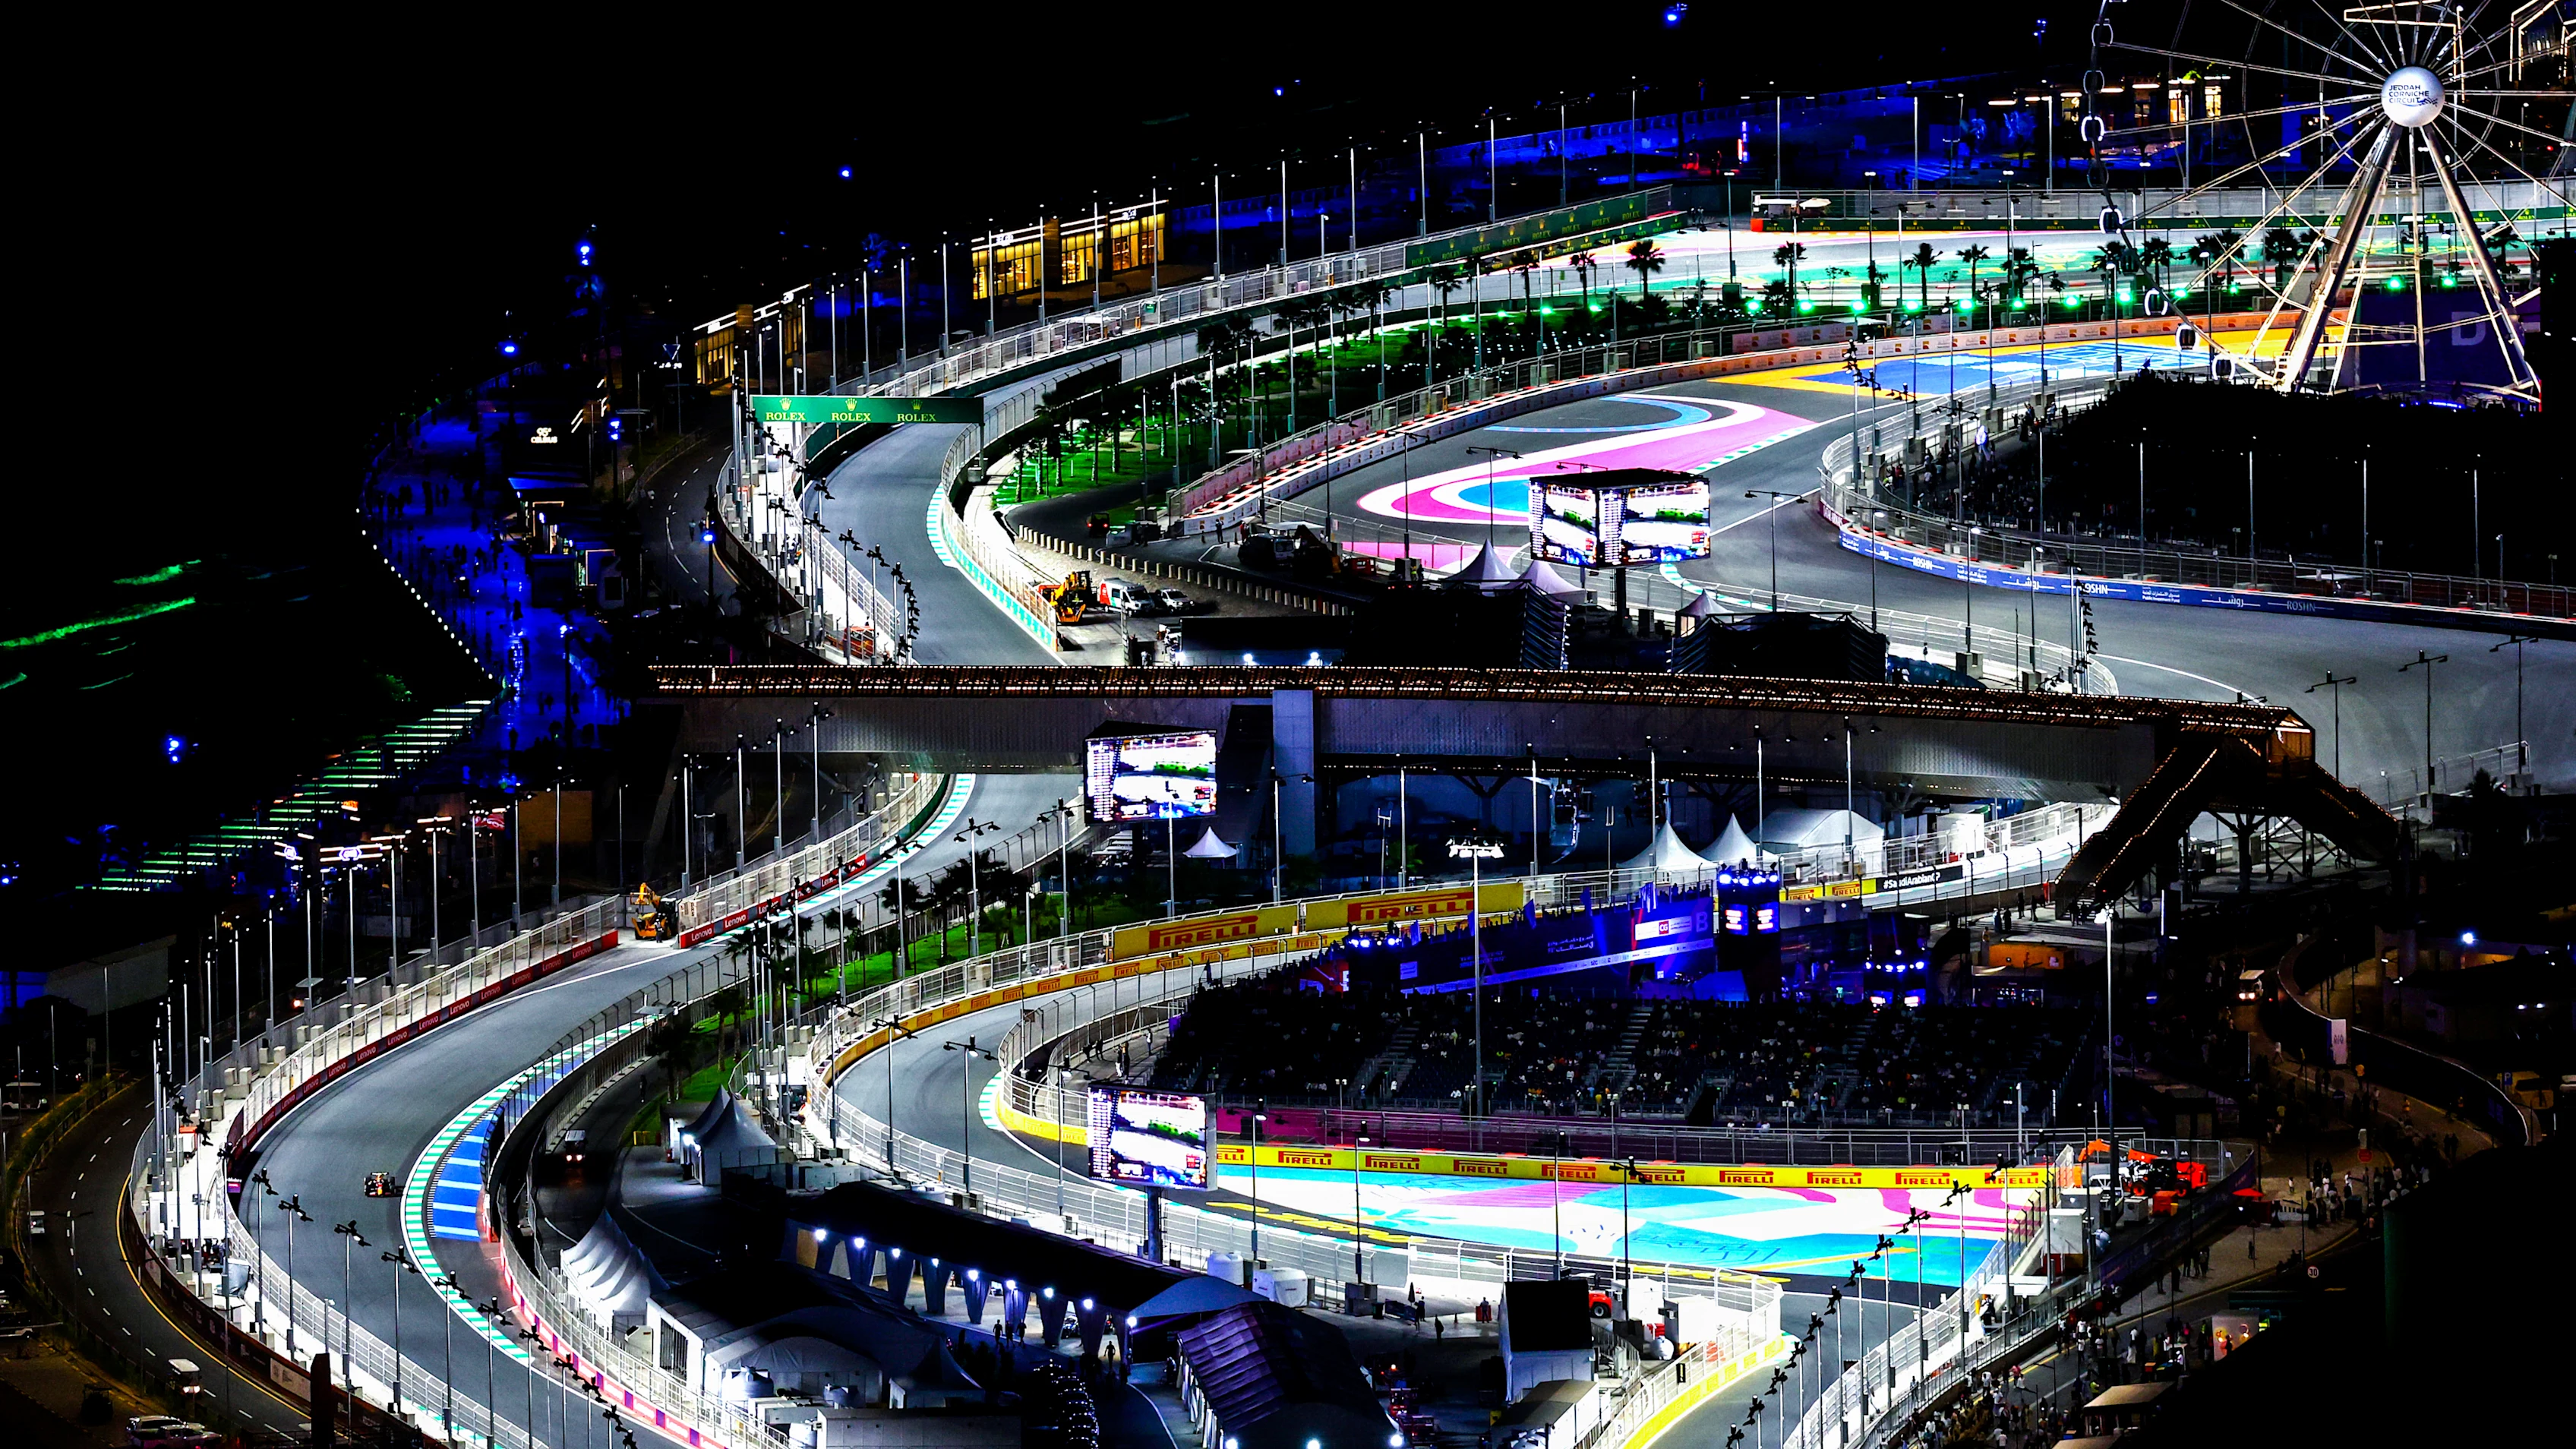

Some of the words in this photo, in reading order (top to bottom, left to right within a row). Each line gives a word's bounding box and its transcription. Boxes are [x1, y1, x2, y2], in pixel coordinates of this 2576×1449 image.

[1592, 216, 1610, 226] ROLEX
[1622, 210, 1640, 220] ROLEX
[1532, 230, 1552, 240] ROLEX
[1561, 223, 1580, 233] ROLEX
[1472, 244, 1491, 254] ROLEX
[1502, 237, 1521, 247] ROLEX
[1411, 257, 1432, 266] ROLEX
[1442, 250, 1460, 260] ROLEX
[2451, 311, 2486, 346] D
[766, 412, 806, 421] ROLEX
[832, 412, 871, 421] ROLEX
[897, 413, 936, 422] ROLEX
[1913, 557, 1933, 570] ROSHN
[2287, 600, 2316, 612] ROSHN
[1833, 884, 1860, 895] PIRELLI
[1347, 892, 1475, 923] PIRELLI
[724, 914, 747, 929] Lenovo
[1659, 923, 1668, 932] CG
[1696, 911, 1708, 933] B
[691, 927, 712, 942] Lenovo
[1149, 915, 1258, 949] PIRELLI
[1297, 935, 1327, 948] PIRELLI
[572, 945, 592, 959] Lenovo
[542, 958, 561, 972] Lenovo
[1156, 955, 1184, 968] PIRELLI
[1114, 962, 1140, 977] PIRELLI
[512, 971, 531, 985] Lenovo
[1075, 970, 1099, 984] PIRELLI
[1037, 978, 1061, 993] PIRELLI
[481, 986, 500, 1000] Lenovo
[1002, 987, 1023, 1001] PIRELLI
[450, 1000, 469, 1015] Lenovo
[419, 1015, 439, 1030] Lenovo
[387, 1031, 407, 1046] Lenovo
[357, 1046, 377, 1062] Lenovo
[328, 1062, 346, 1077] Lenovo
[2505, 1072, 2511, 1081] P
[304, 1078, 319, 1094] Lenovo
[1217, 1148, 1245, 1161] ELLI
[1277, 1151, 1332, 1166] PIRELLI
[1365, 1154, 1419, 1170] PIRELLI
[1453, 1159, 1508, 1174] PIRELLI
[1541, 1163, 1596, 1179] PIRELLI
[1719, 1170, 1774, 1184] PIRELLI
[1807, 1171, 1862, 1185] PIRELLI
[1895, 1172, 1950, 1185] PIRELLI
[2309, 1268, 2317, 1277] 30
